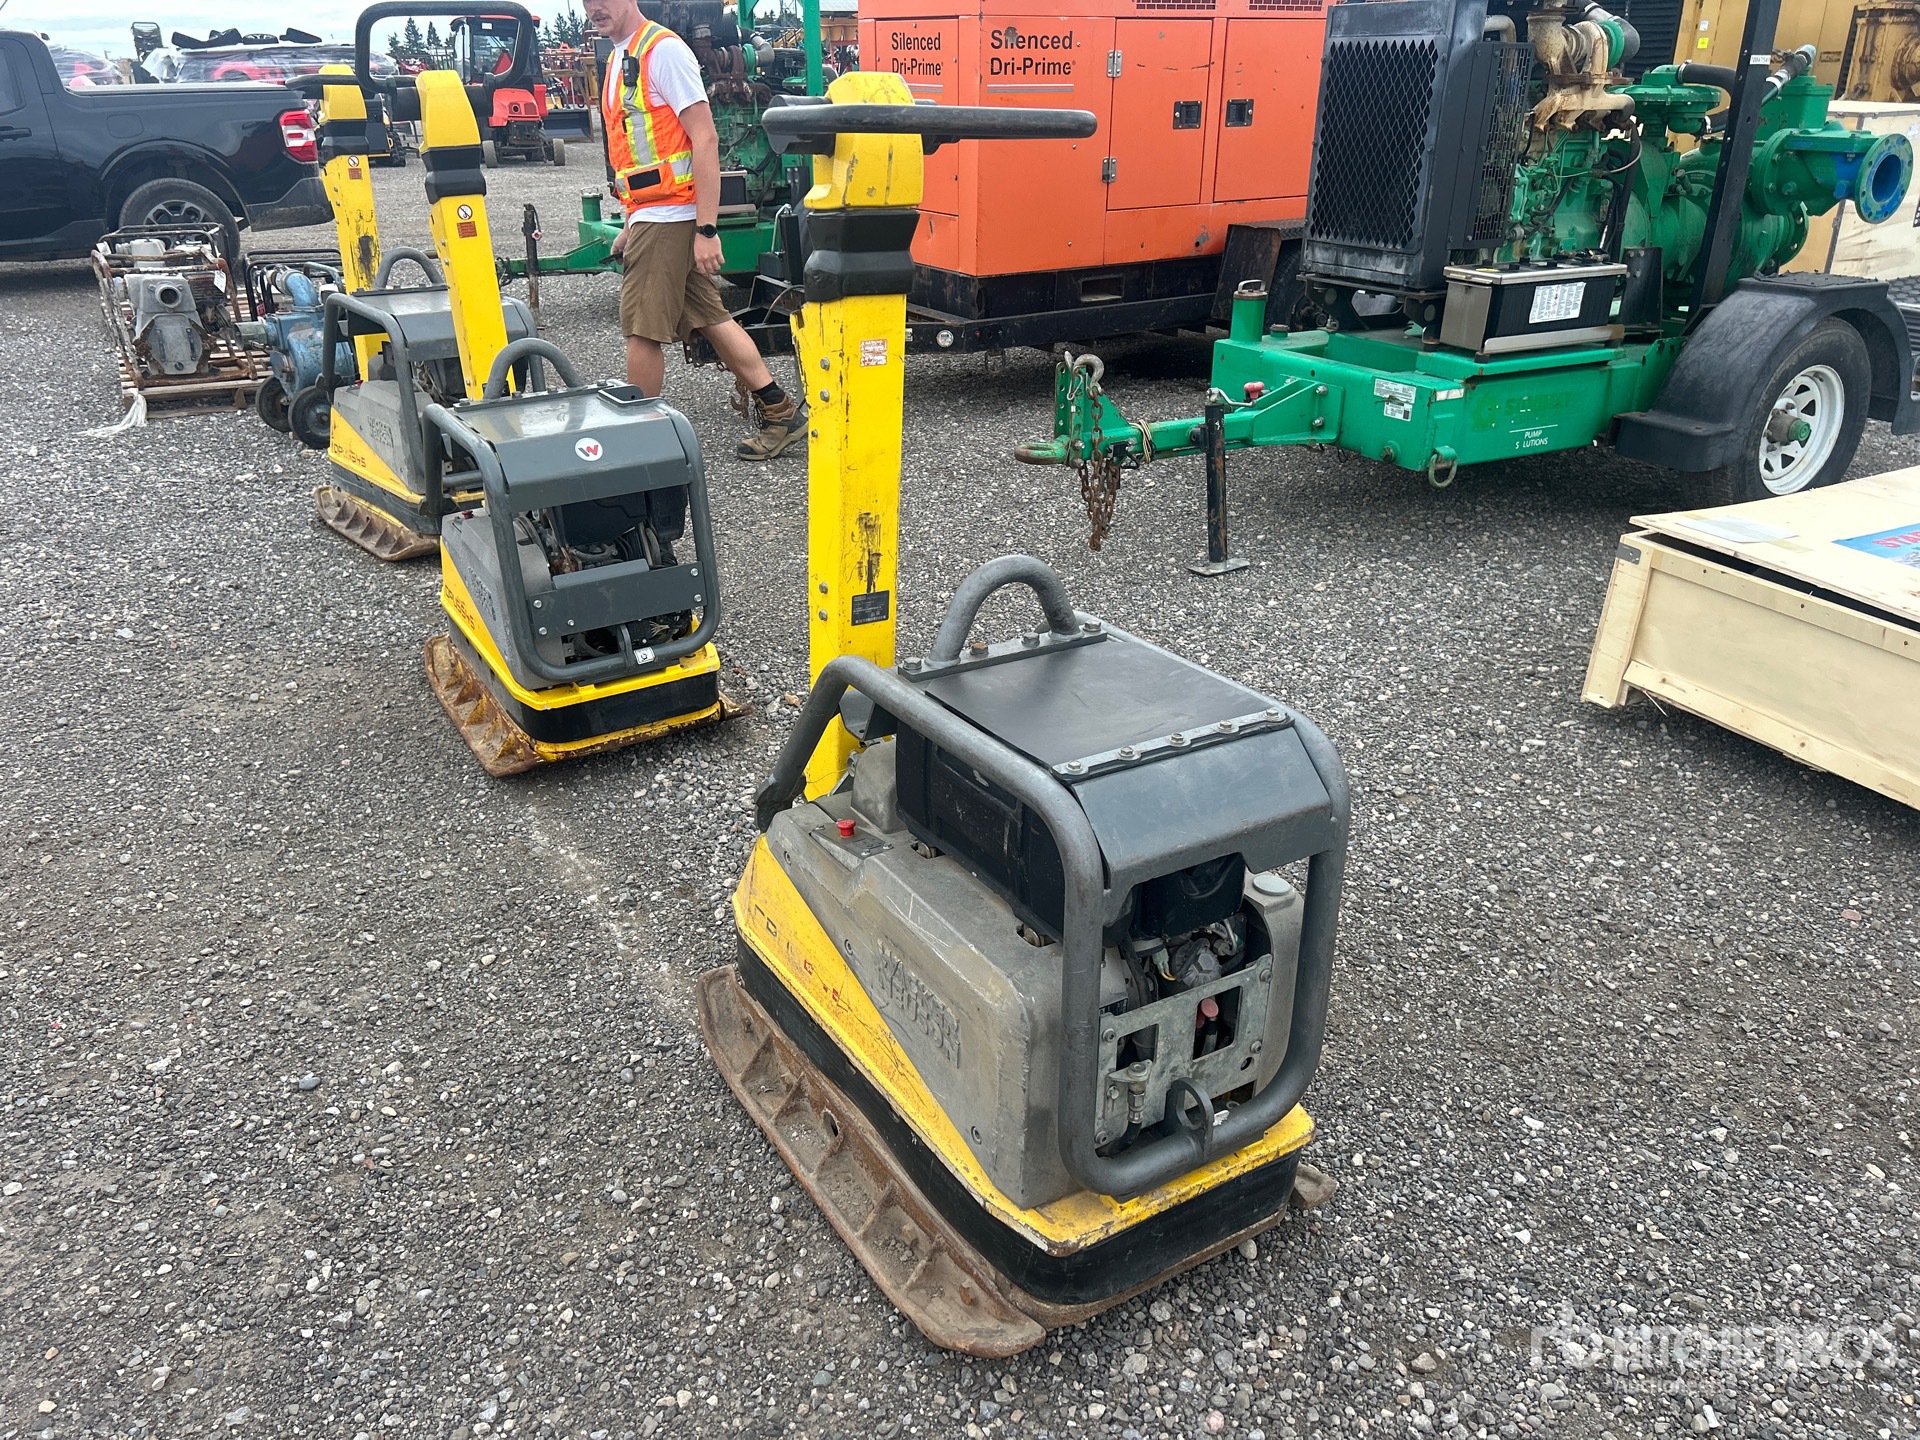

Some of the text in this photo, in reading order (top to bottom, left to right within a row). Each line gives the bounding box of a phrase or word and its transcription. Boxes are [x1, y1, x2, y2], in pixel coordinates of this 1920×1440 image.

[891, 32, 941, 51] Silenced
[990, 29, 1073, 50] Sienced
[891, 57, 942, 76] Dri-Prime
[990, 57, 1072, 75] Dri-Prime
[1524, 429, 1543, 439] PUMP
